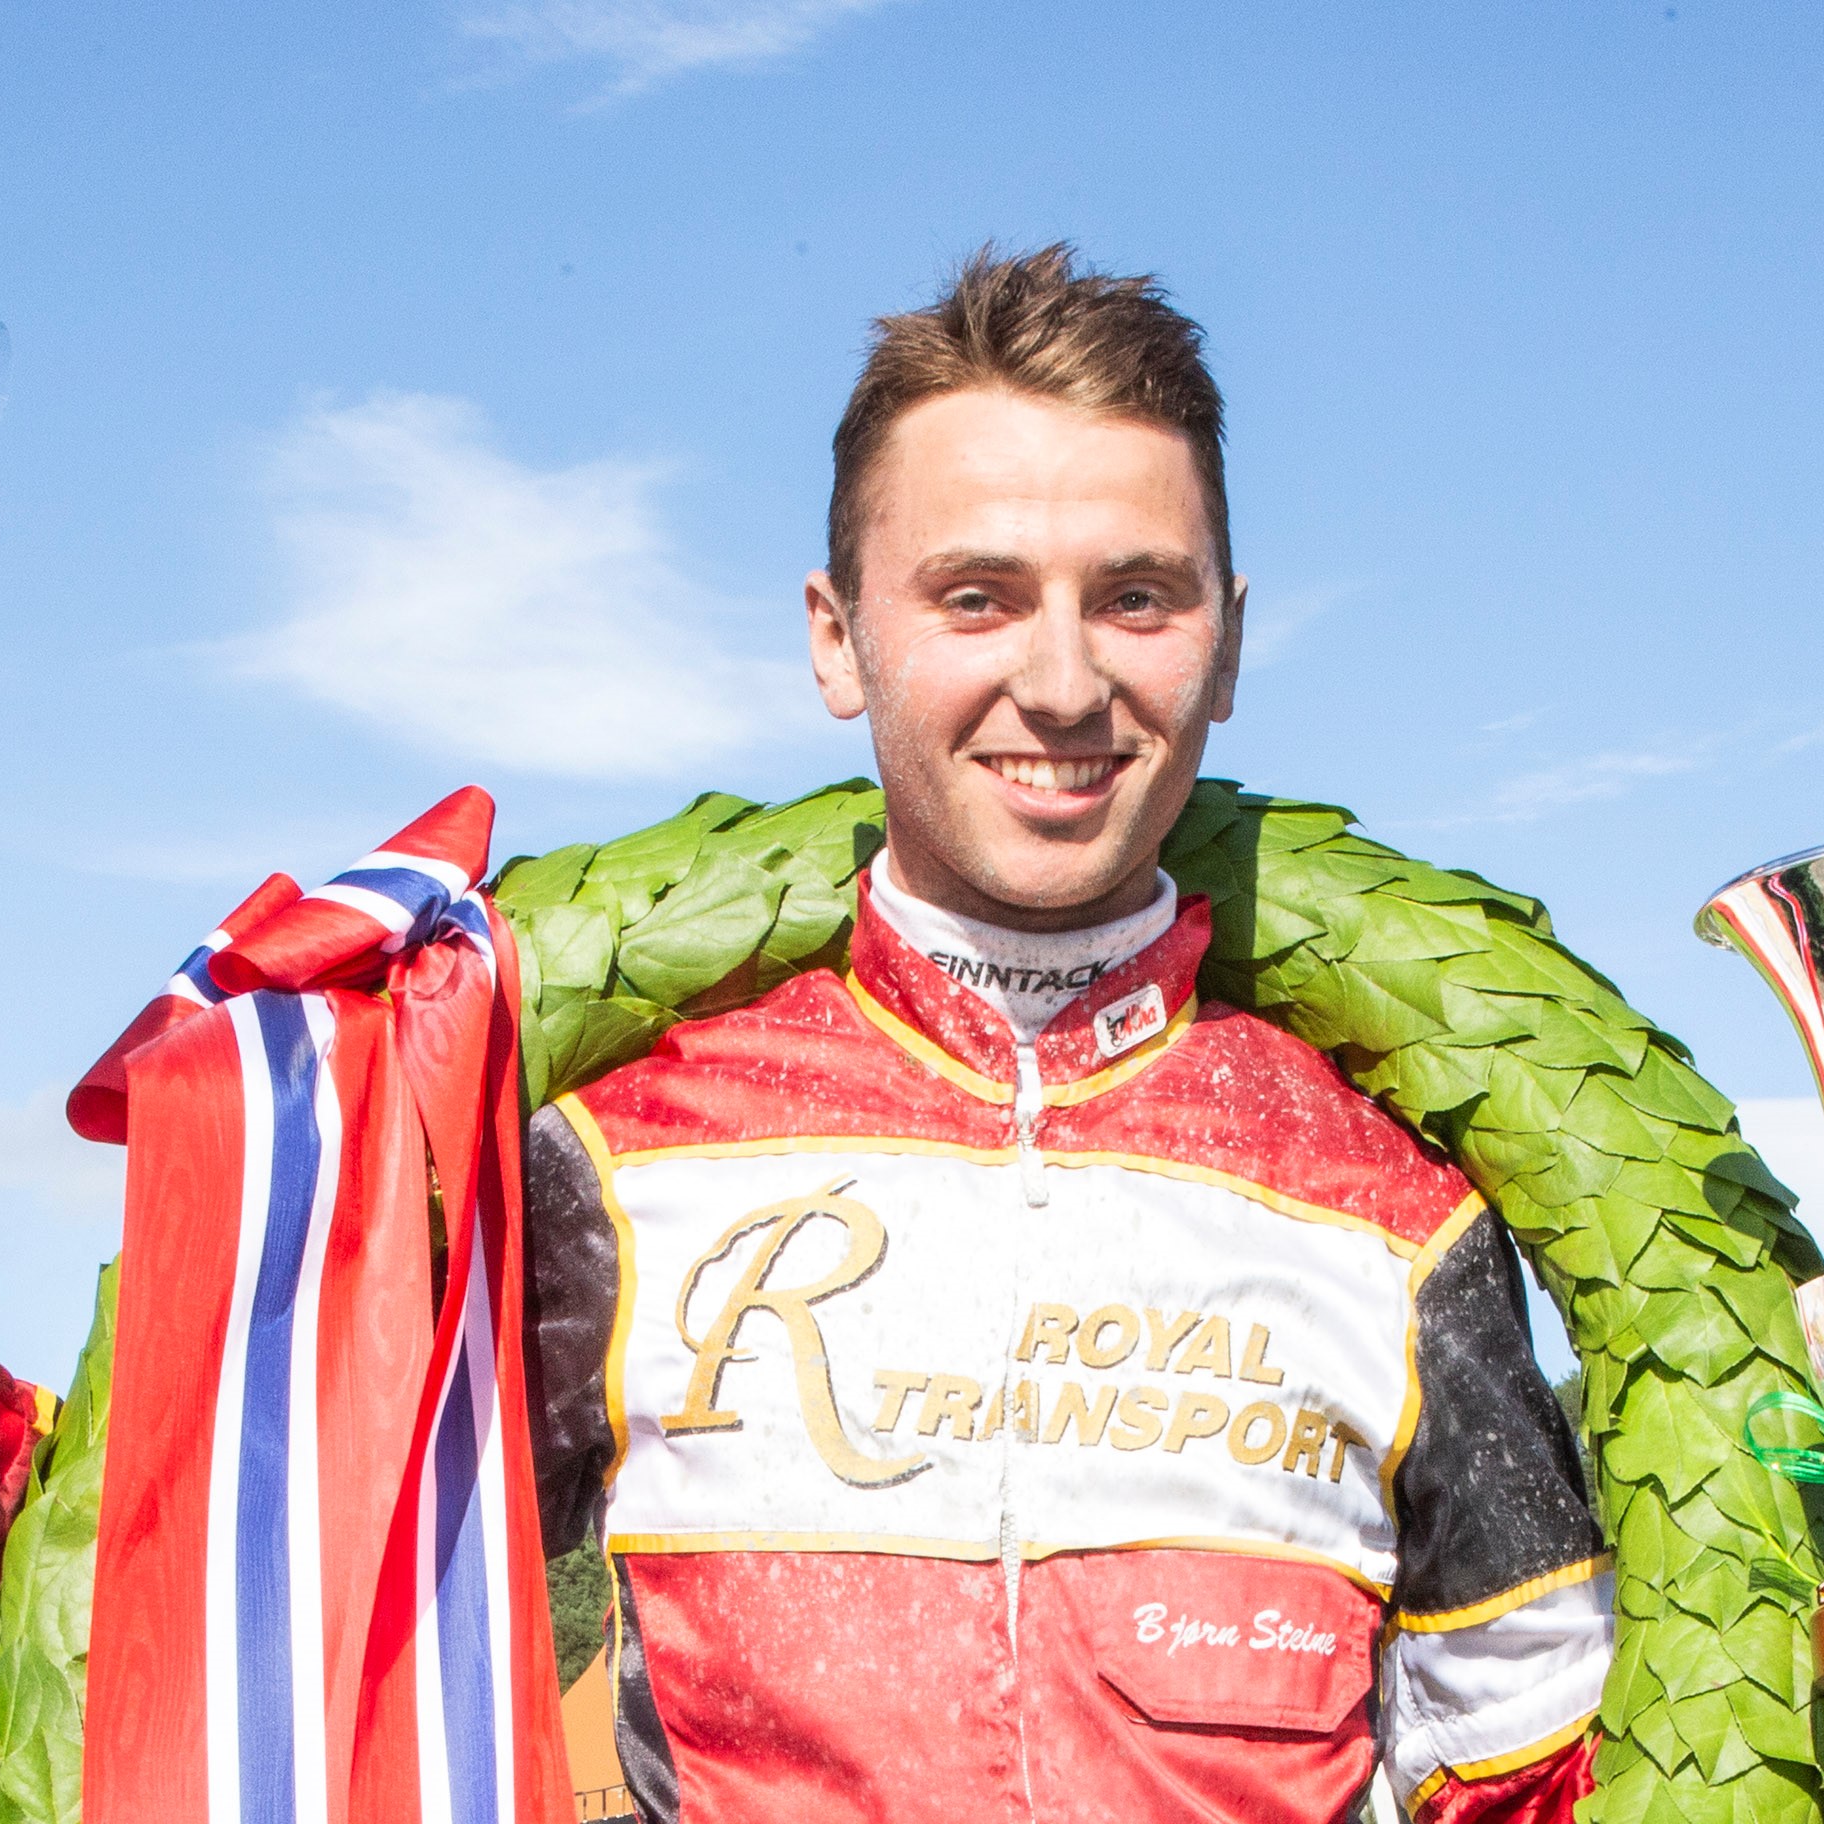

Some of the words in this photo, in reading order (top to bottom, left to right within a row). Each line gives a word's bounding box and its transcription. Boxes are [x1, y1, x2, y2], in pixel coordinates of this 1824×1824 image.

[927, 951, 1112, 994] FINNTACK
[1015, 1302, 1286, 1387] ROYAL
[870, 1369, 1371, 1484] TRANSPORT
[1132, 1601, 1241, 1658] Bjørn
[1248, 1609, 1338, 1656] Steine
